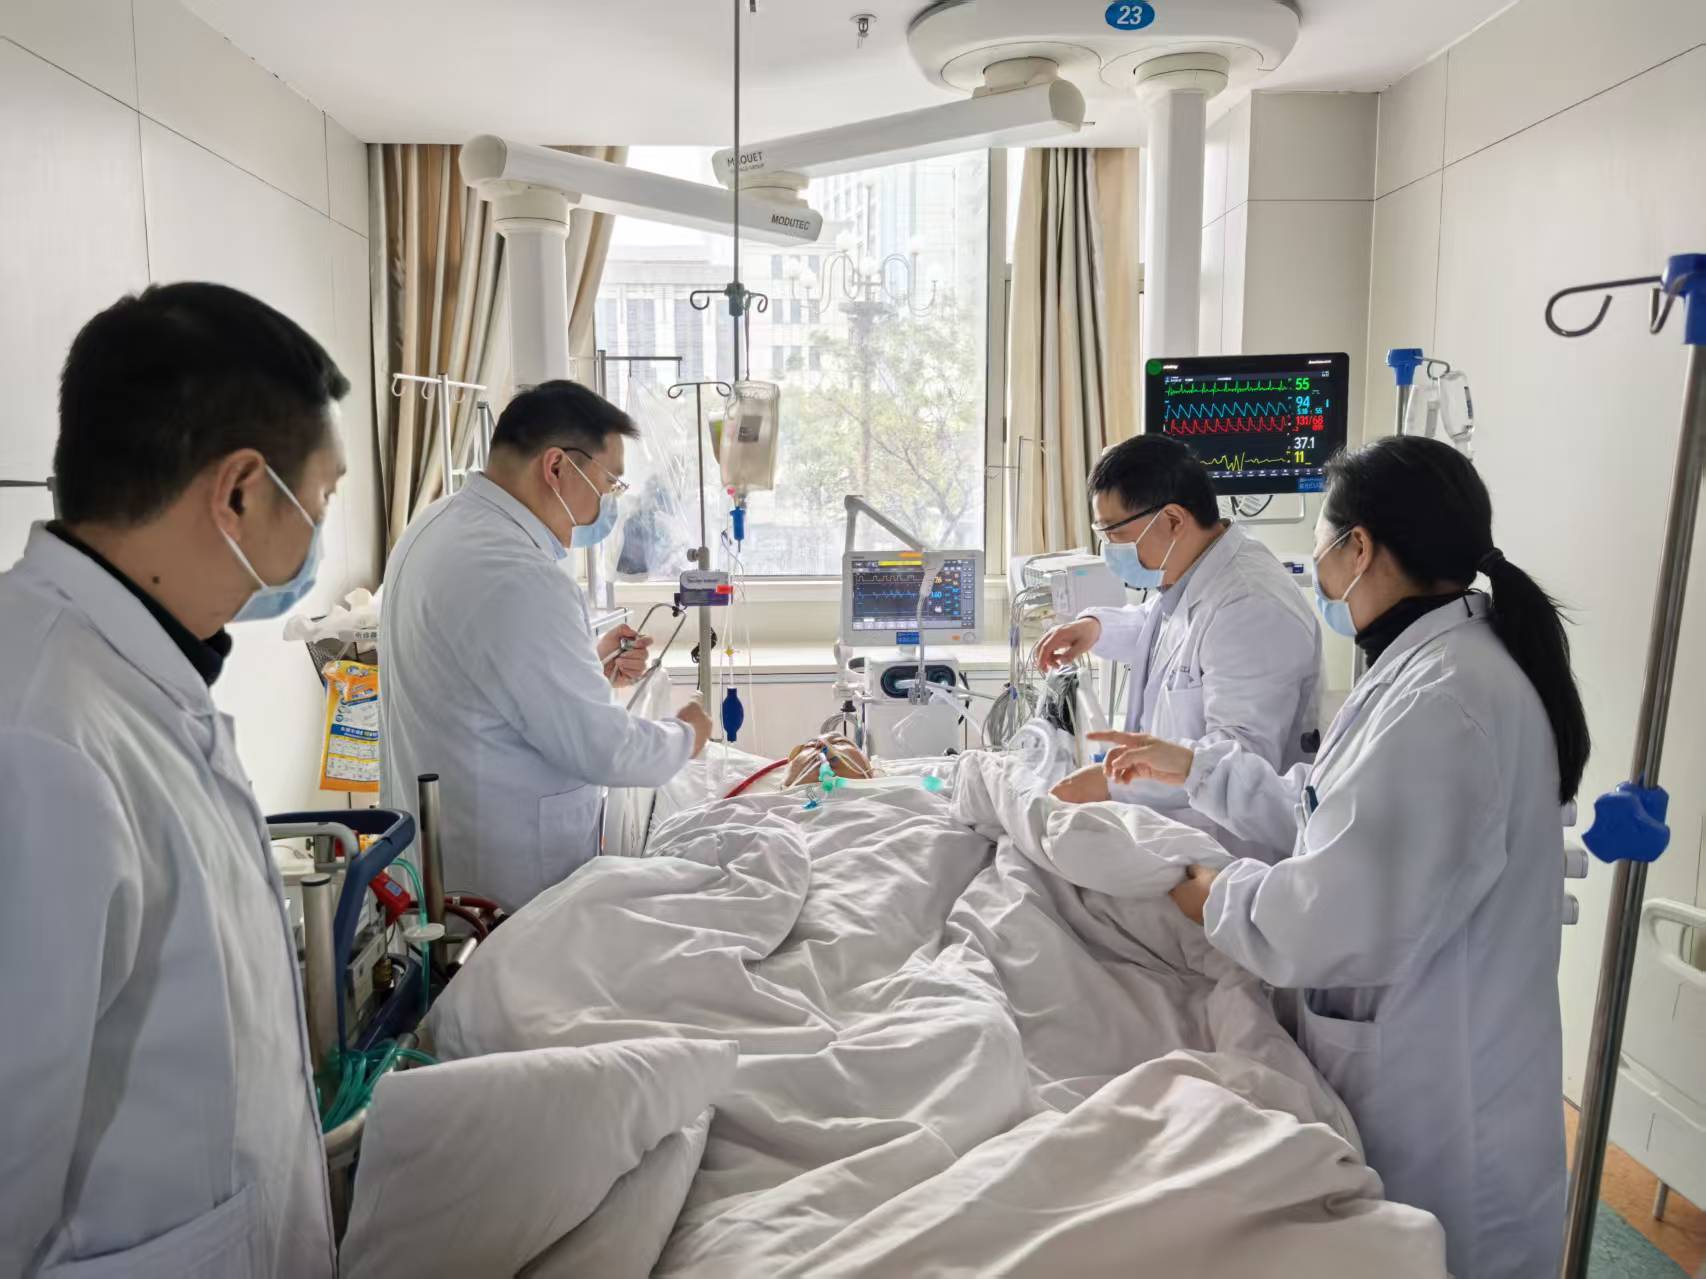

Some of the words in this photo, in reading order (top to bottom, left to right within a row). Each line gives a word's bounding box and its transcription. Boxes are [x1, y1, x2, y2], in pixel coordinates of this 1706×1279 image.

[1117, 5, 1143, 24] 23
[727, 151, 763, 167] MQUET
[771, 214, 810, 231] MODUTEC
[1295, 377, 1310, 391] 55
[1295, 395, 1310, 409] 94
[1294, 436, 1315, 449] 37.1
[1295, 450, 1305, 463] 11
